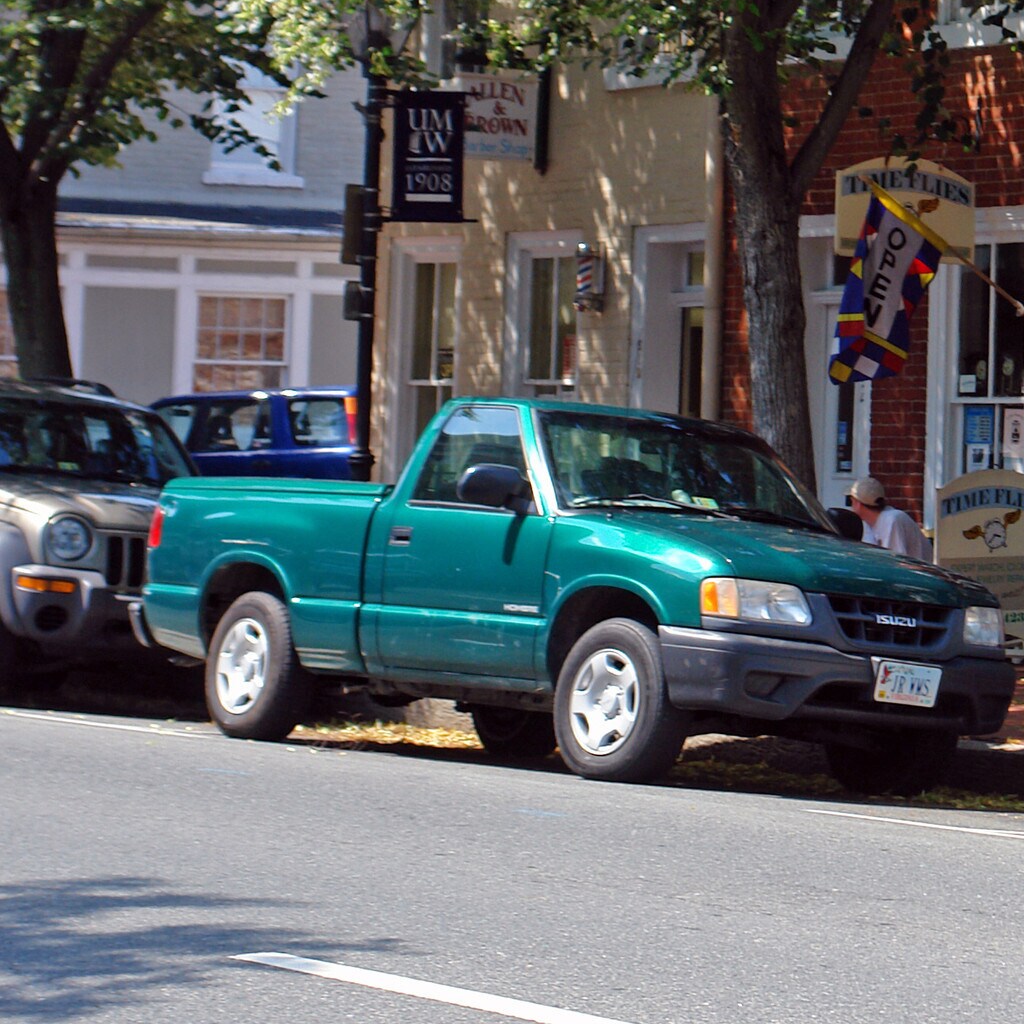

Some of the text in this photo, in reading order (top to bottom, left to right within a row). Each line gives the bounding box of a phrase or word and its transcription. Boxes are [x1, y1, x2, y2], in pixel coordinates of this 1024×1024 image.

[405, 172, 454, 192] 1908
[863, 227, 907, 328] OPEN
[943, 488, 990, 514] TIME
[876, 614, 917, 628] ISUZU
